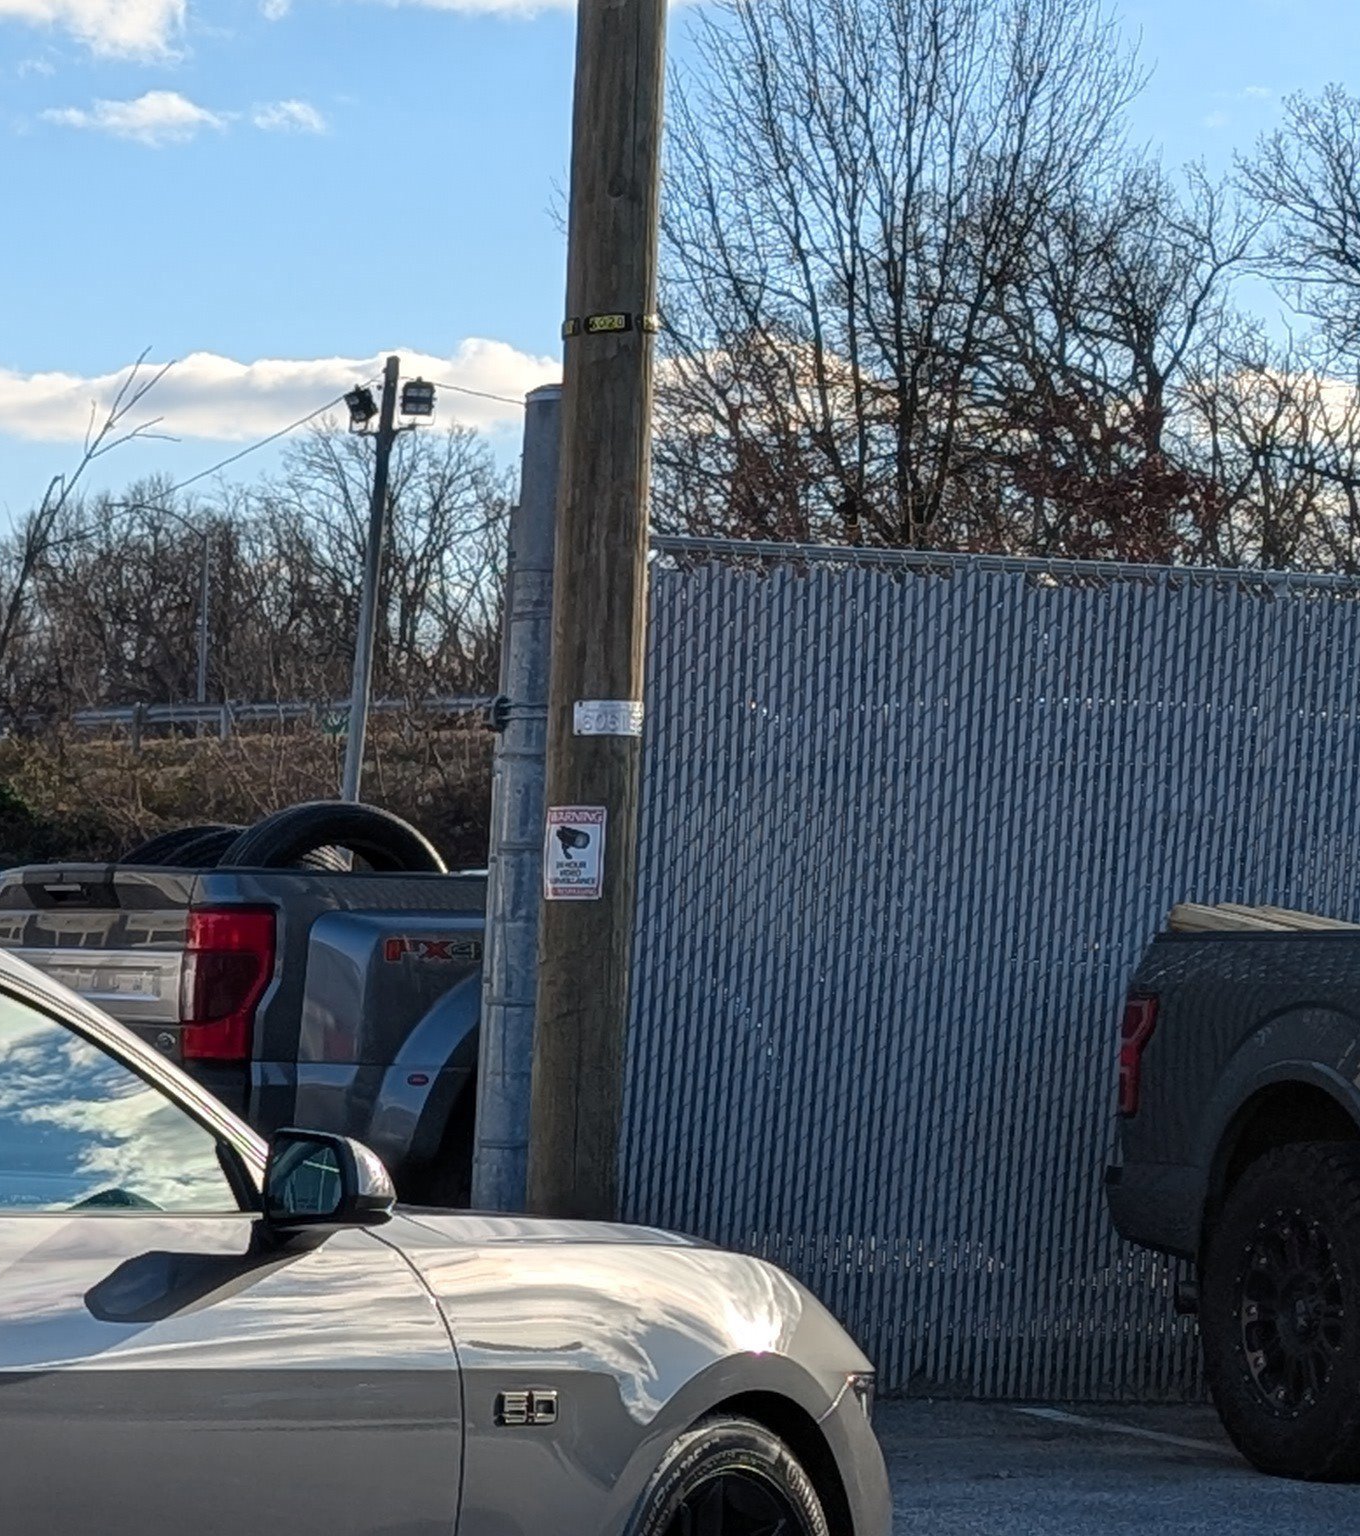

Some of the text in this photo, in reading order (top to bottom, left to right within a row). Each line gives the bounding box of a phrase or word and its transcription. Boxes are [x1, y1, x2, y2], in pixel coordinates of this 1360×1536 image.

[549, 811, 603, 823] WARNING
[385, 938, 484, 964] FX4
[497, 1390, 559, 1425] 5.0
